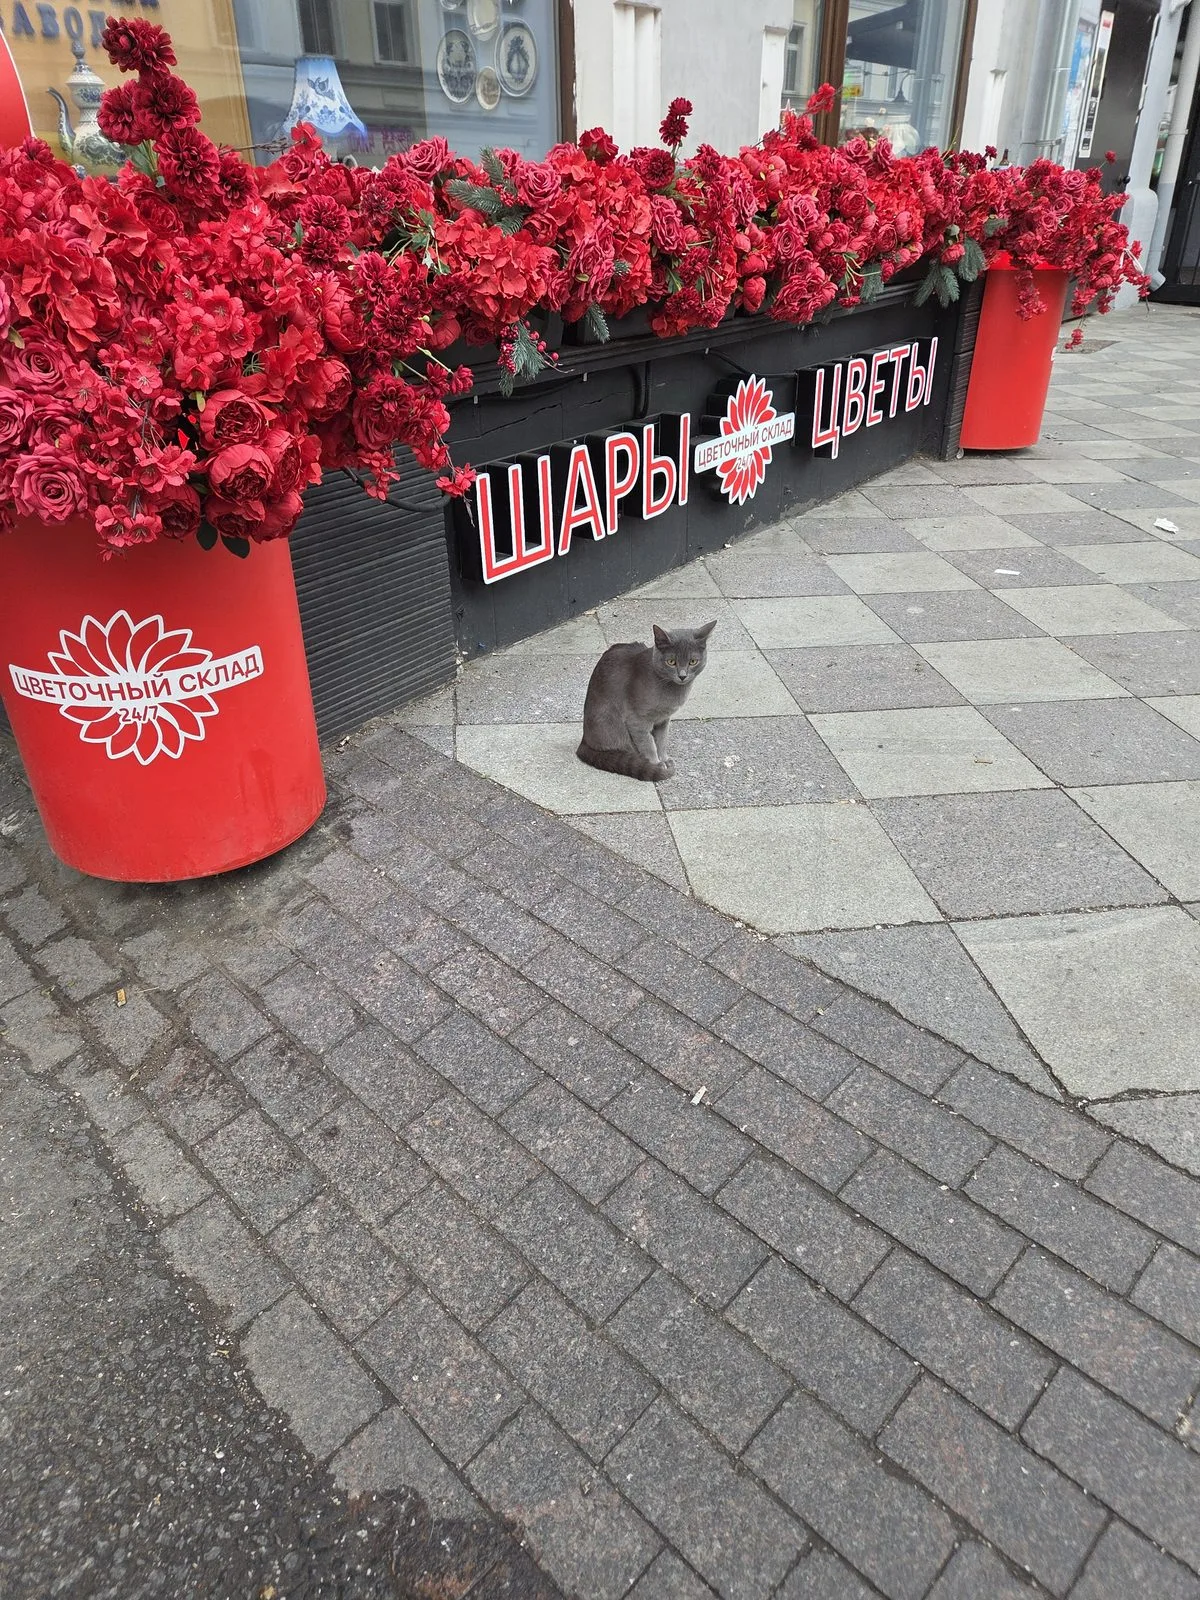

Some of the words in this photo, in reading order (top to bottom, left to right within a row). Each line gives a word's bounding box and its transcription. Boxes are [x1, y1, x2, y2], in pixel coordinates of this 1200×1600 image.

[812, 337, 938, 459] ЦВЕТЫ
[698, 426, 760, 468] ЦВЕТОЧНЫЙ
[761, 419, 792, 442] СКЛАД
[737, 453, 753, 470] 24/7
[475, 413, 691, 585] ШАРЫ
[14, 672, 172, 702] ЦВЕТОЧНЫЙ
[178, 653, 261, 694] СКЛАД
[119, 705, 159, 723] 24/7
